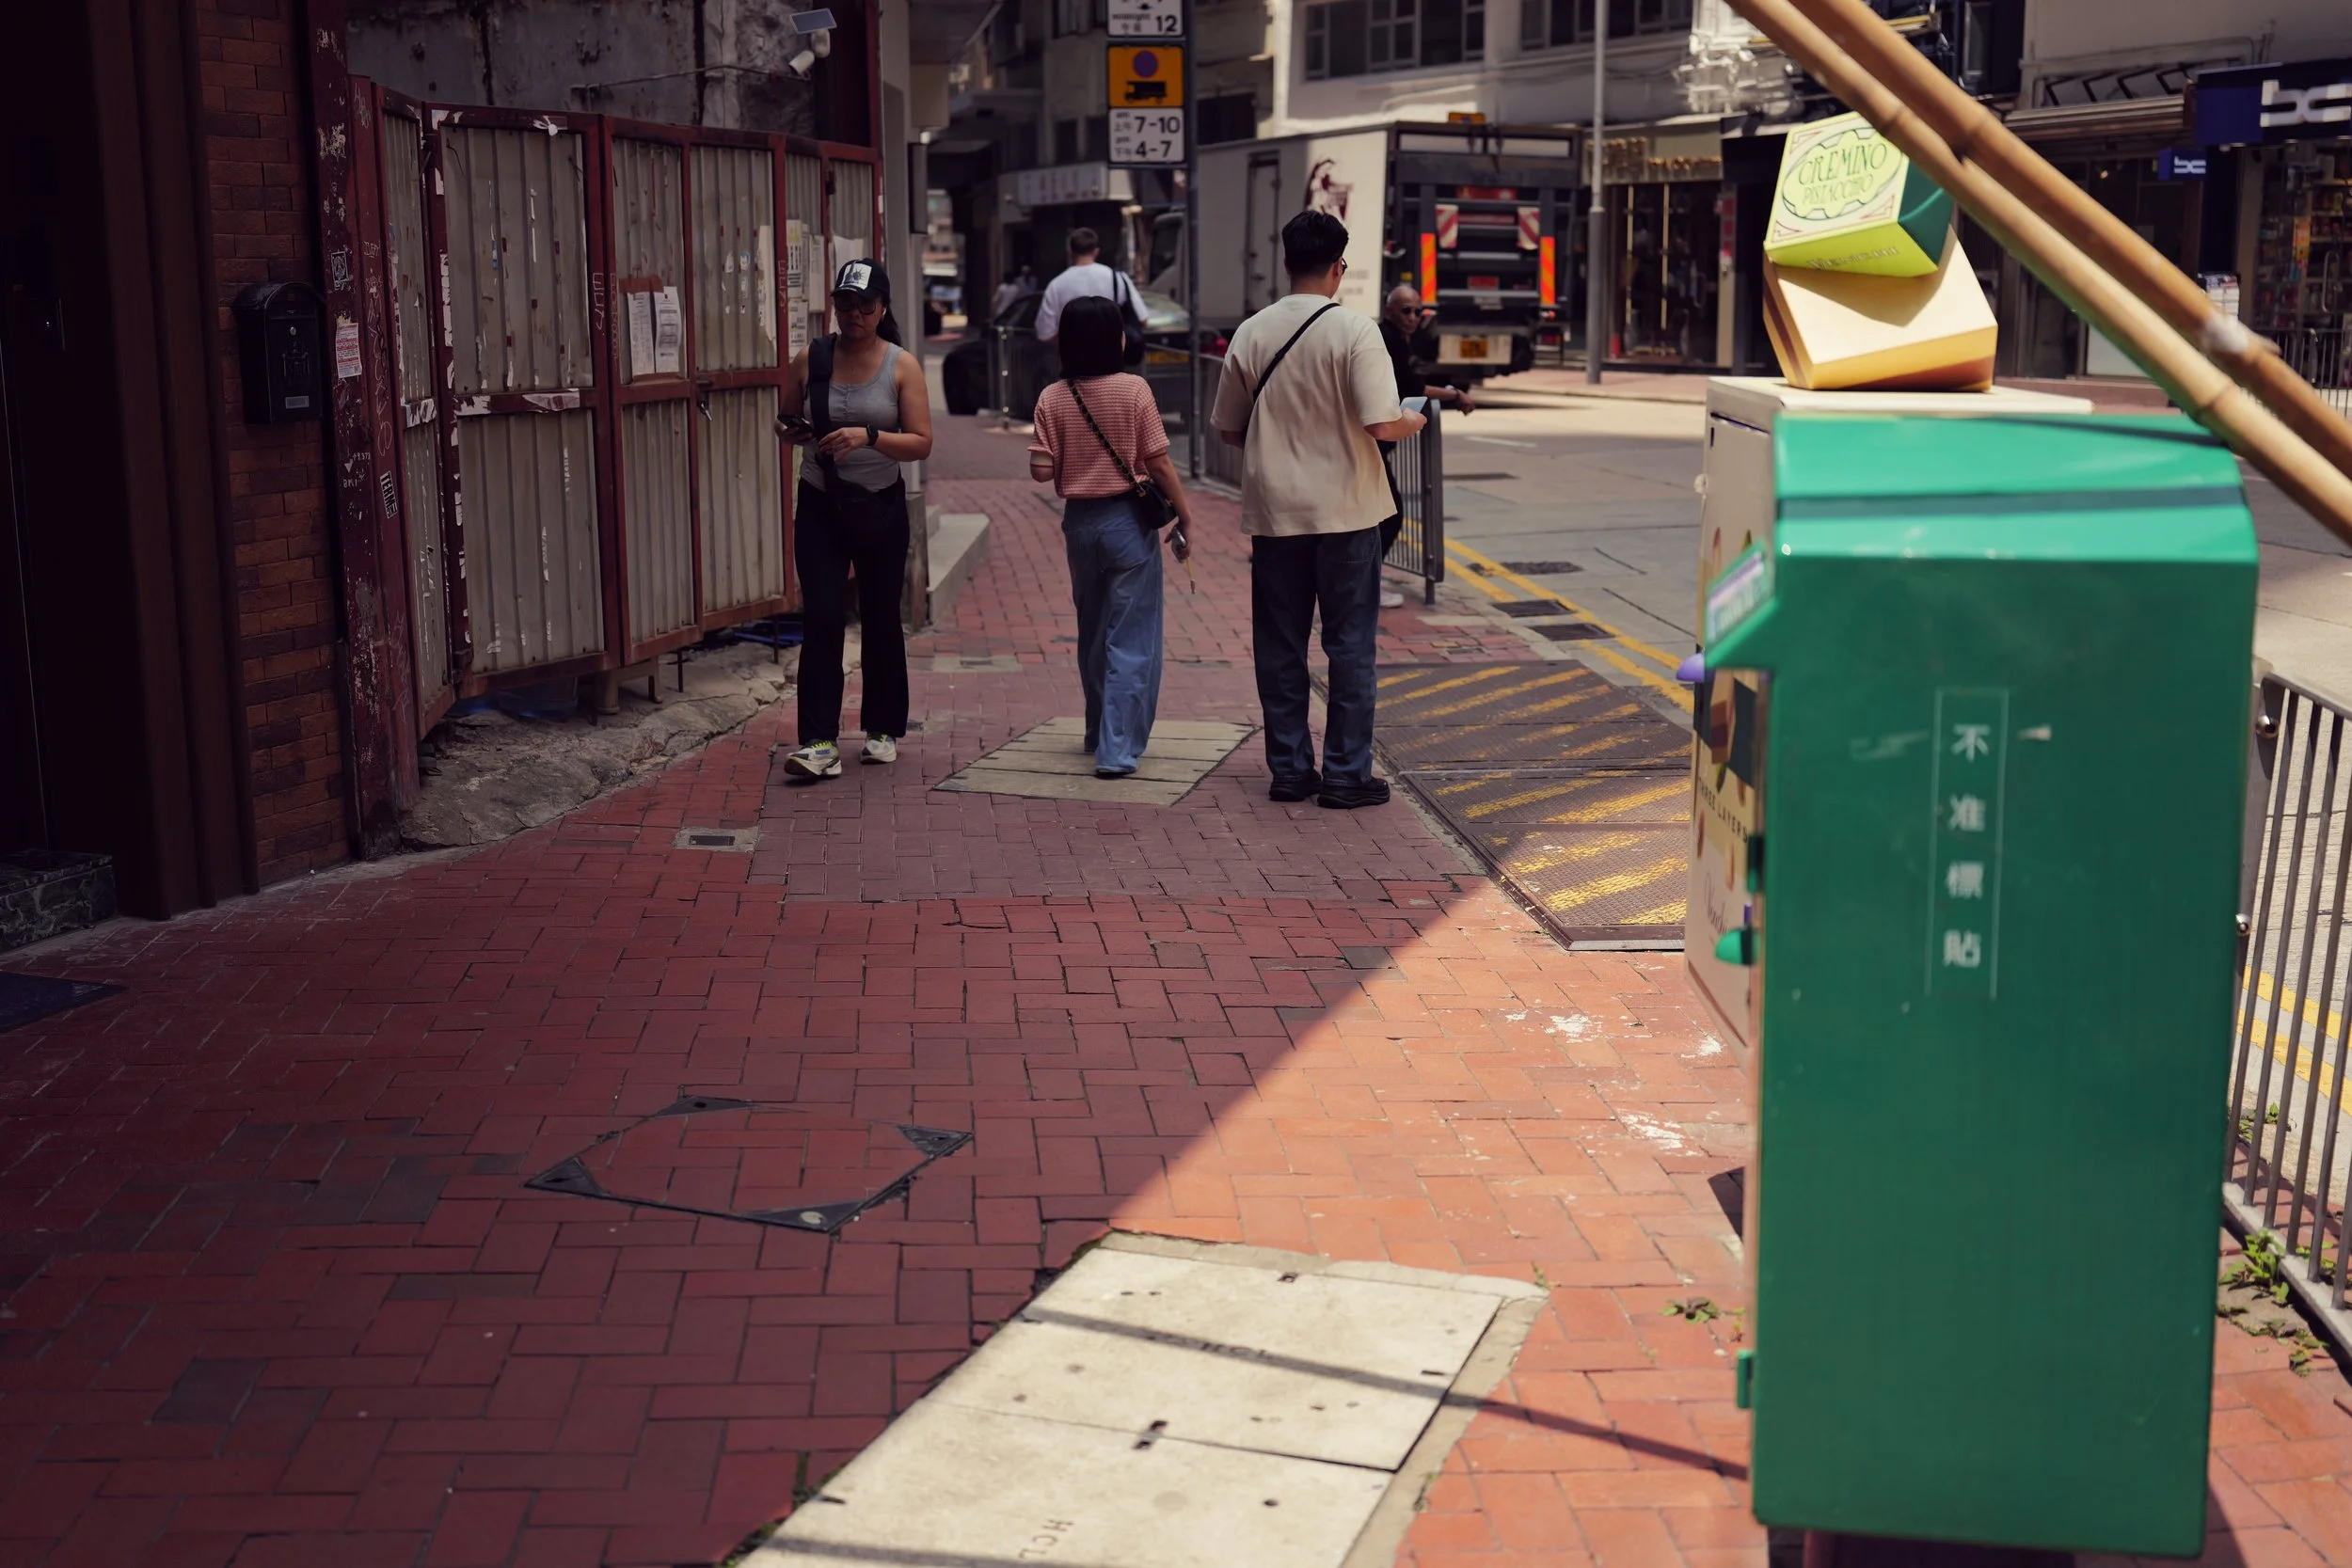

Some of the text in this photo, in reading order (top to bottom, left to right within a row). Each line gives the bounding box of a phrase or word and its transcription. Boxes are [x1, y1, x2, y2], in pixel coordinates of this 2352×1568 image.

[1155, 14, 1178, 32] 12
[1134, 116, 1180, 134] 7-10
[1135, 140, 1172, 158] 4-7
[1798, 143, 1887, 185] CREMINO
[1717, 805, 1748, 844] LAYERS
[1942, 722, 1991, 968] 不准標貼
